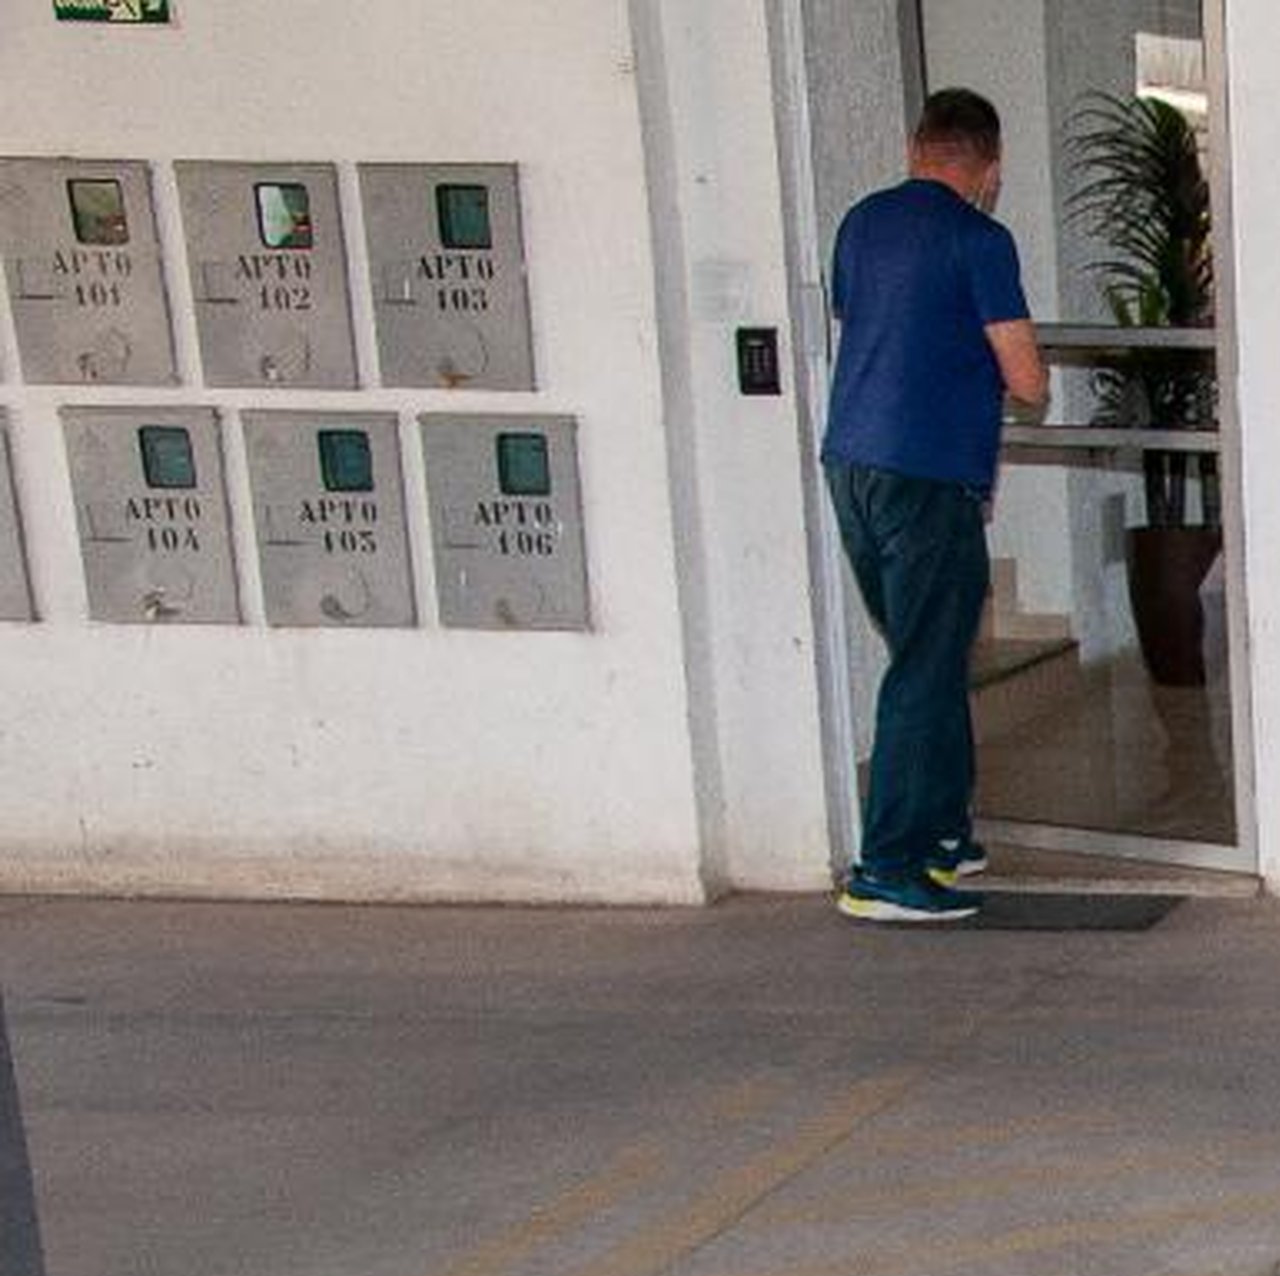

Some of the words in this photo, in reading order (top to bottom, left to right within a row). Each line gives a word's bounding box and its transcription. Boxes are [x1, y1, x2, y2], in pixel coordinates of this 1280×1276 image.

[53, 251, 132, 276] APTO
[236, 255, 311, 279] APTO
[417, 255, 495, 279] APTO
[75, 284, 121, 306] 101
[260, 286, 312, 310] 102
[437, 289, 488, 311] 103
[125, 498, 200, 521] APTO
[300, 499, 377, 523] APTO
[474, 502, 552, 526] APTO
[146, 527, 200, 551] 104
[322, 530, 377, 553] 105
[498, 531, 553, 555] 106
